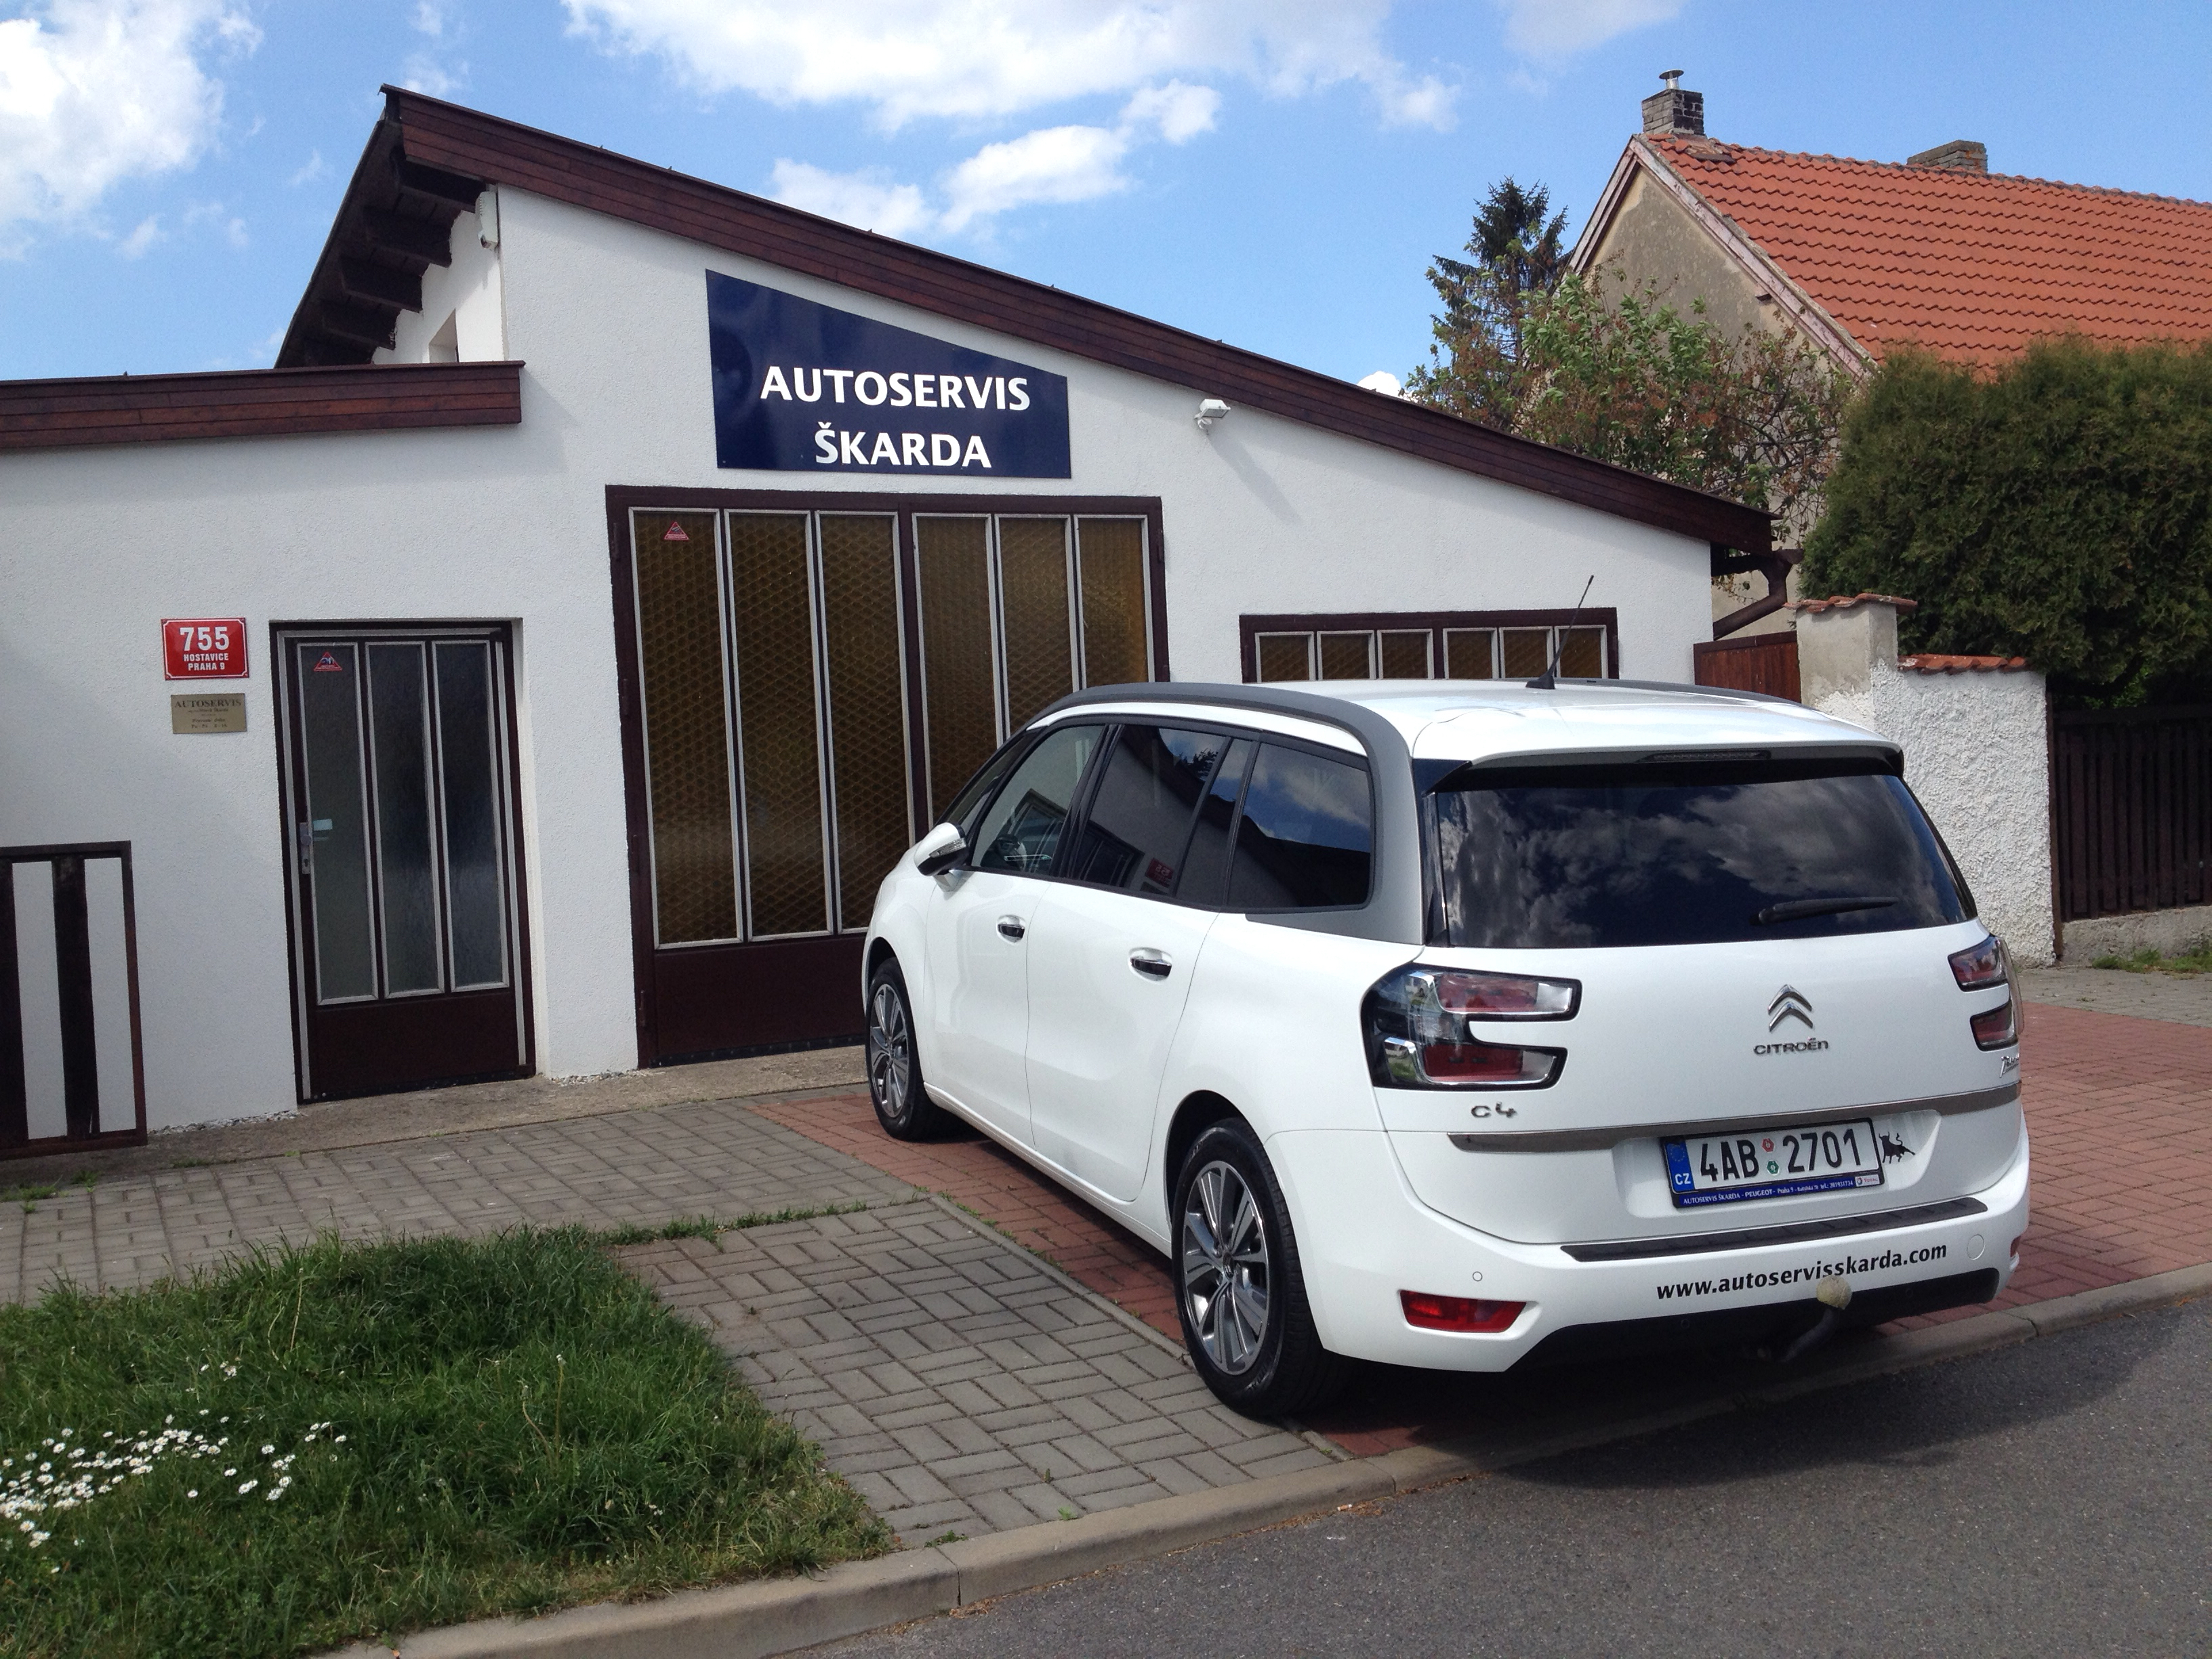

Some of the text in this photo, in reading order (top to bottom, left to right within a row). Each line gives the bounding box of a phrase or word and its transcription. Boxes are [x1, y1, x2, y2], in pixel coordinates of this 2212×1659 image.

[760, 366, 1030, 411] AUTOSERVIS
[815, 422, 991, 468] ŠKARDA
[180, 626, 230, 651] 755
[184, 653, 229, 662] HOSTAVICE
[188, 662, 225, 671] PRAHA 9
[174, 699, 241, 708] AUTOSERVIS
[1471, 1101, 1517, 1118] C4
[1700, 1128, 1862, 1182] 4AB 2701
[1675, 1172, 1692, 1186] CZ
[1683, 1195, 1717, 1204] AUTOSERVIS
[1744, 1189, 1773, 1197] PEUGEOT
[1656, 1244, 1947, 1300] www.autoservisskarda.com
